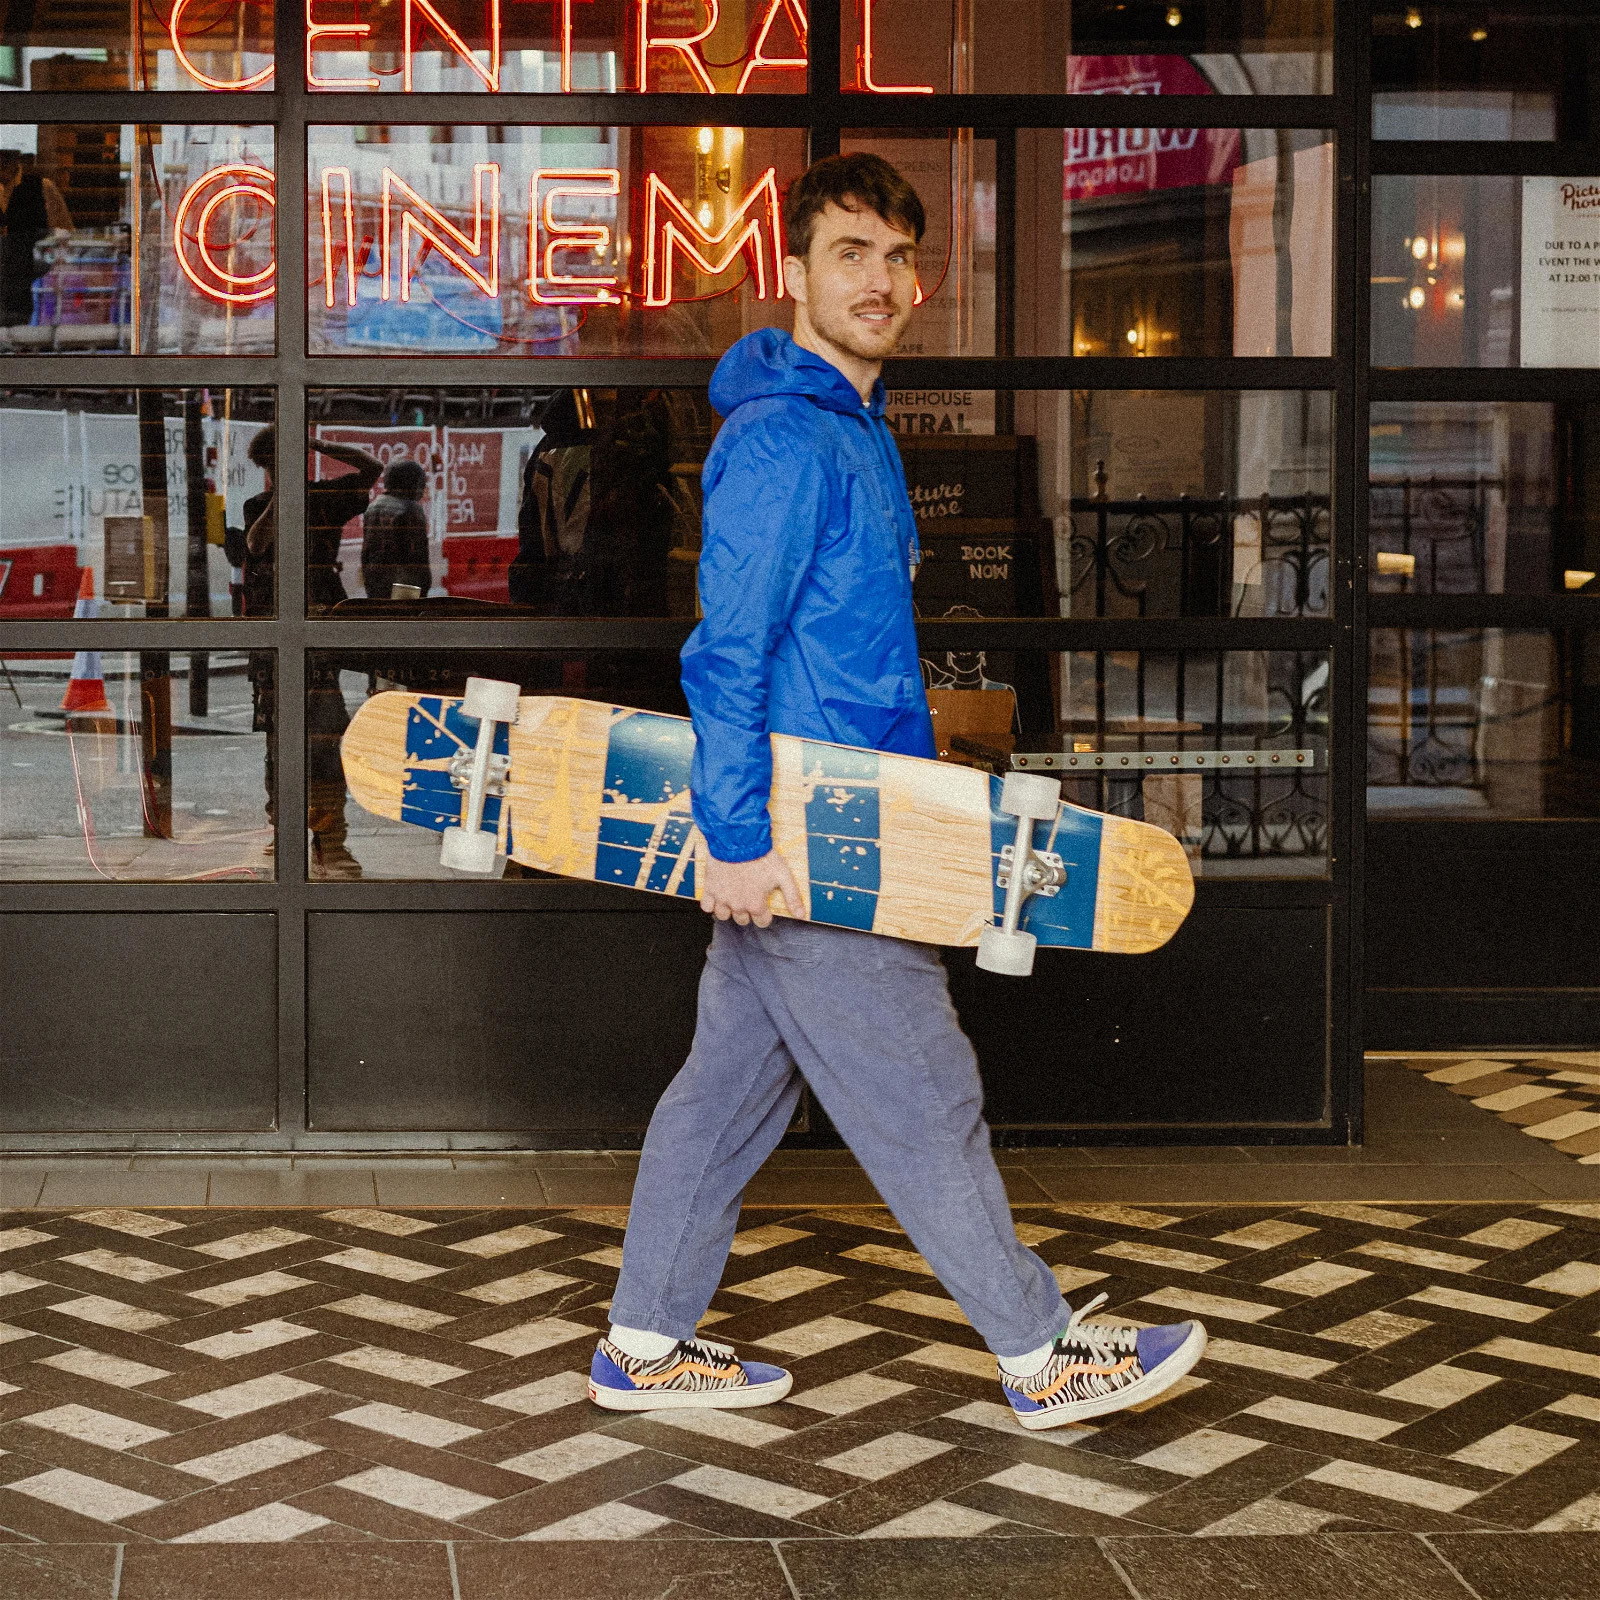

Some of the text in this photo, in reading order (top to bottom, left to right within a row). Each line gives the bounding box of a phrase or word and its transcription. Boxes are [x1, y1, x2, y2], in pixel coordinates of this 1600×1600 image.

[169, 0, 934, 95] CENTRAL
[173, 162, 924, 308] CINEM
[1545, 241, 1565, 250] DUE
[1568, 241, 1582, 250] TO
[1584, 241, 1592, 250] A
[1539, 258, 1570, 267] EVENT
[1573, 258, 1591, 267] THE
[1548, 273, 1561, 283] AT
[1564, 273, 1591, 283] 12:00
[961, 544, 1013, 561] BOOK
[969, 562, 1009, 581] NOW
